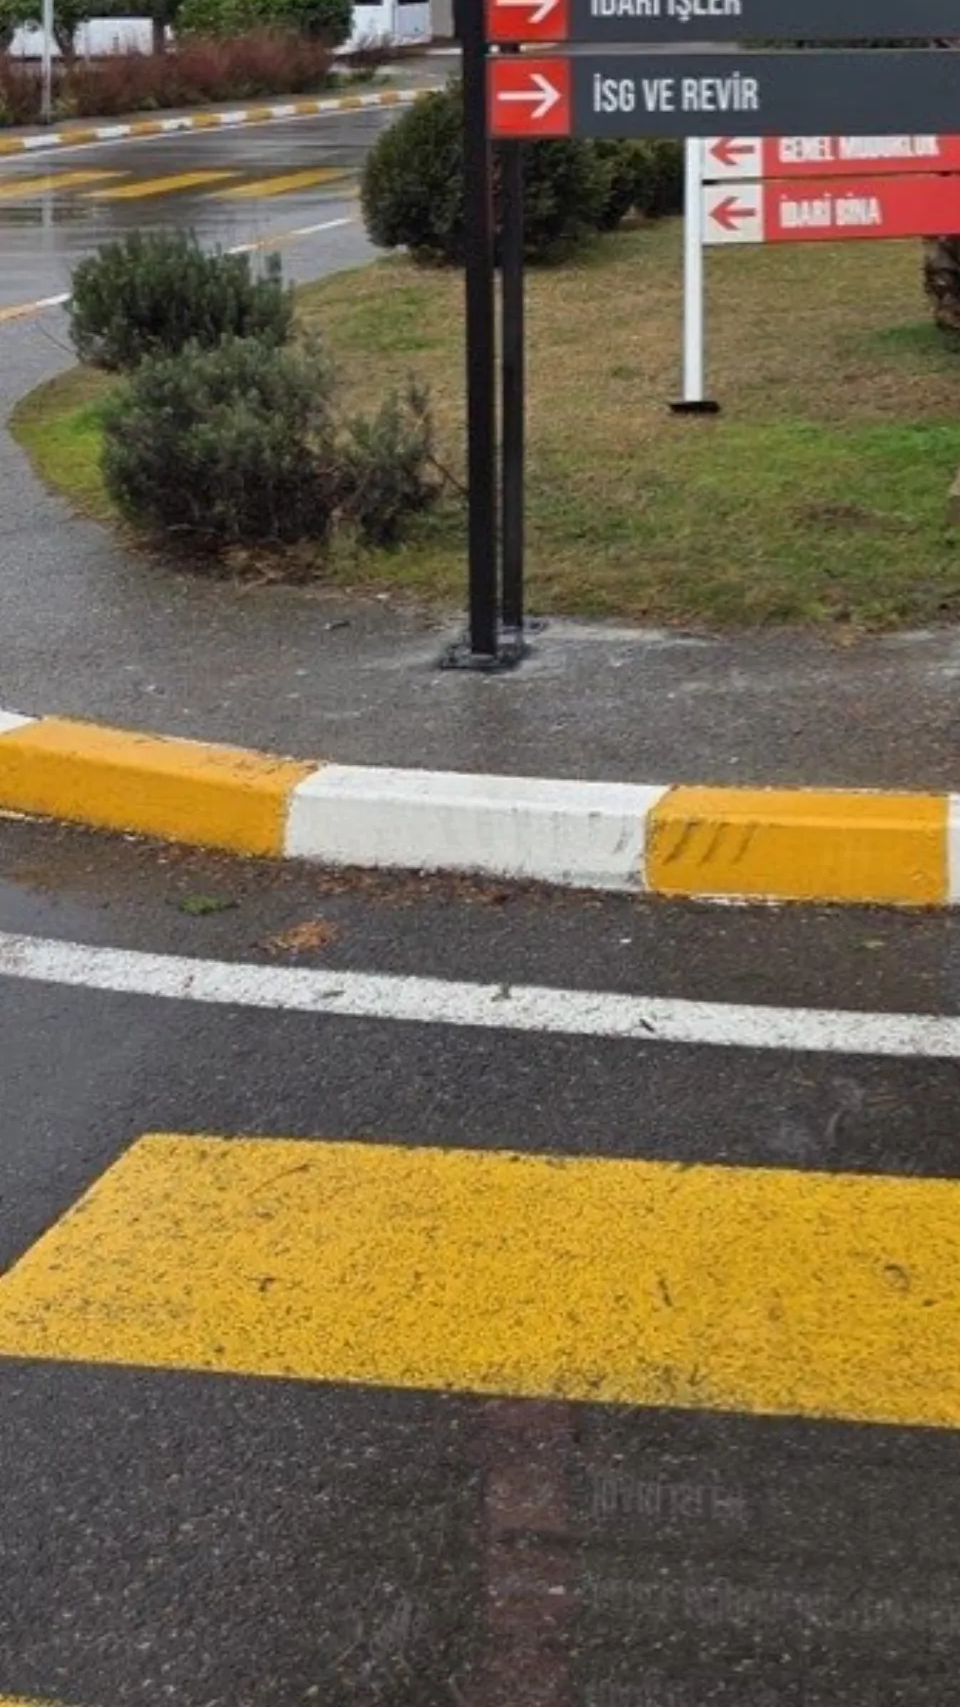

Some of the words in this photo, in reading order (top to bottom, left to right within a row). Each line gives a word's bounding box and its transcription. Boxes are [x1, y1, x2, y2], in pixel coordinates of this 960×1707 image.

[593, 72, 636, 113] İSG
[641, 78, 675, 112] VE
[681, 71, 759, 111] REVİR
